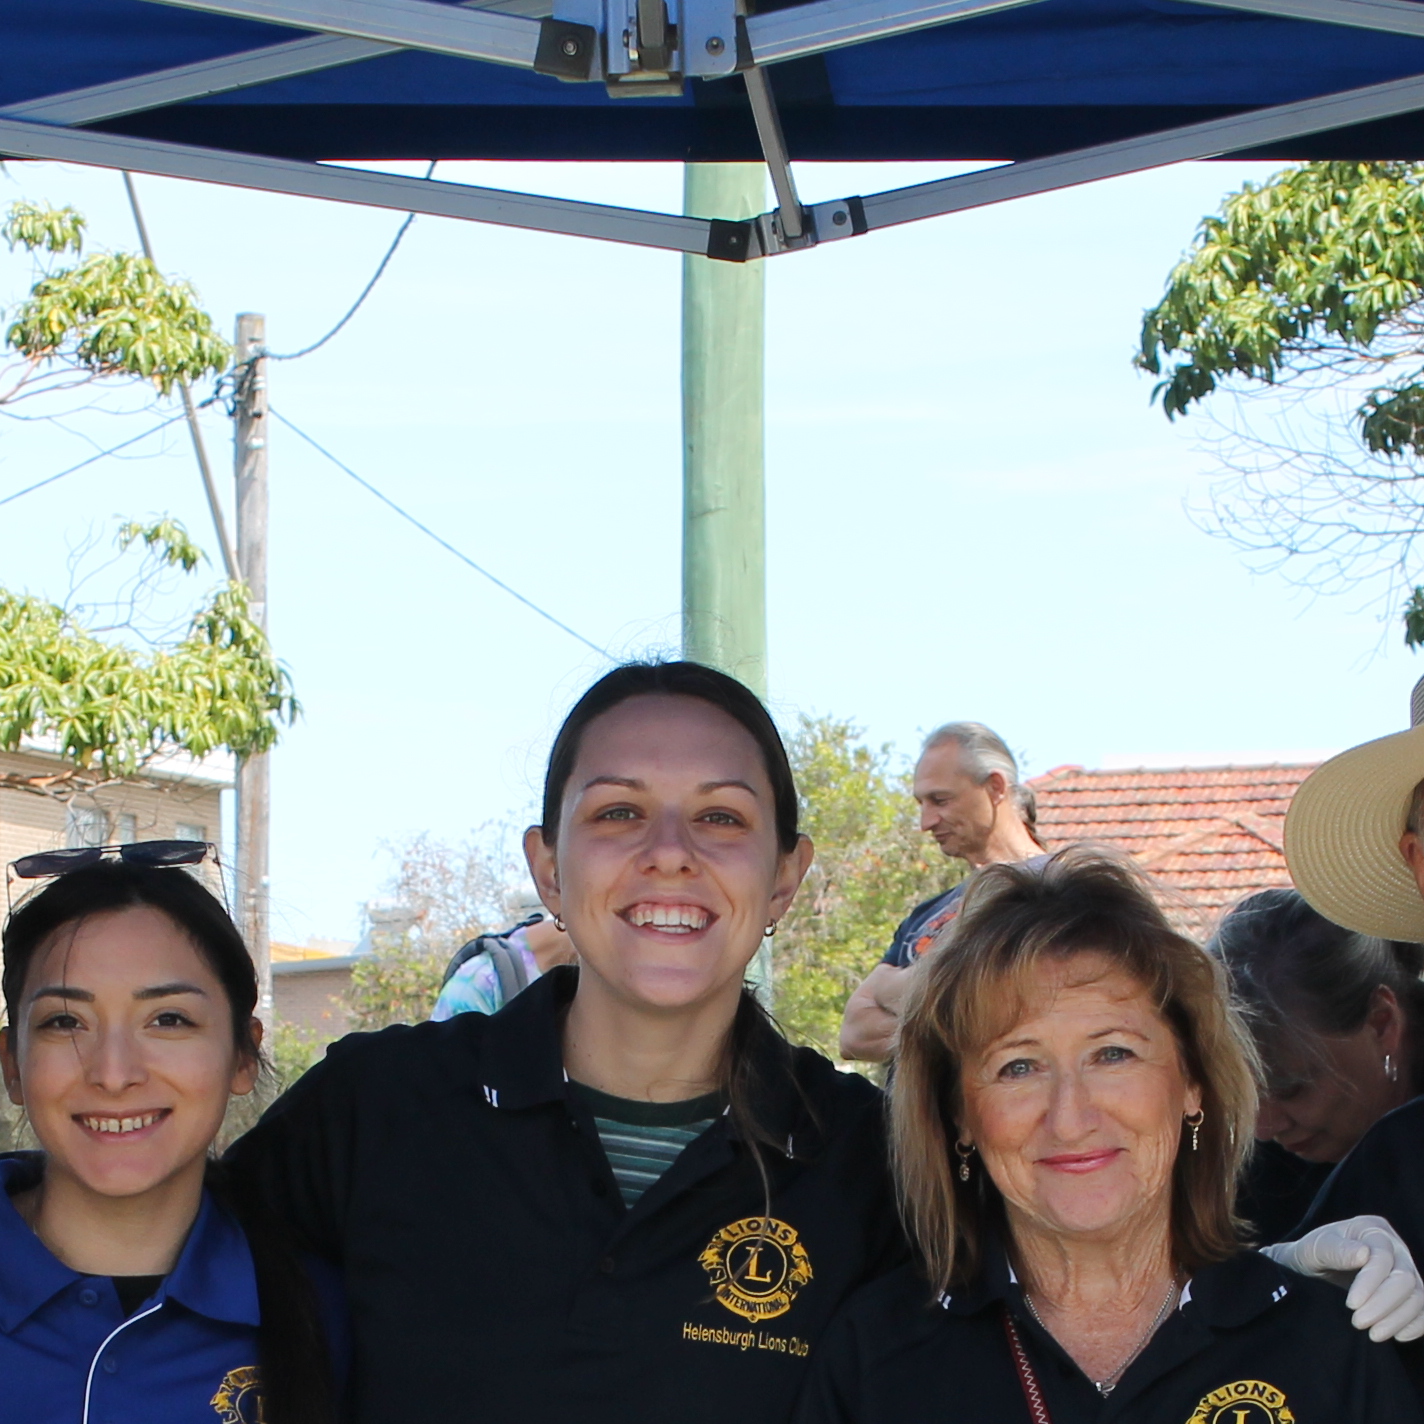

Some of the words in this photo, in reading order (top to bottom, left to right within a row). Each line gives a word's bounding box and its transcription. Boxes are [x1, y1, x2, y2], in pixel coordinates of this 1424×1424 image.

[729, 1219, 792, 1241] LIONS
[744, 1246, 773, 1283] L
[682, 1321, 756, 1351] Helensburgh
[758, 1331, 787, 1352] Lions
[789, 1336, 809, 1357] Club
[1214, 1382, 1279, 1404] LIONS
